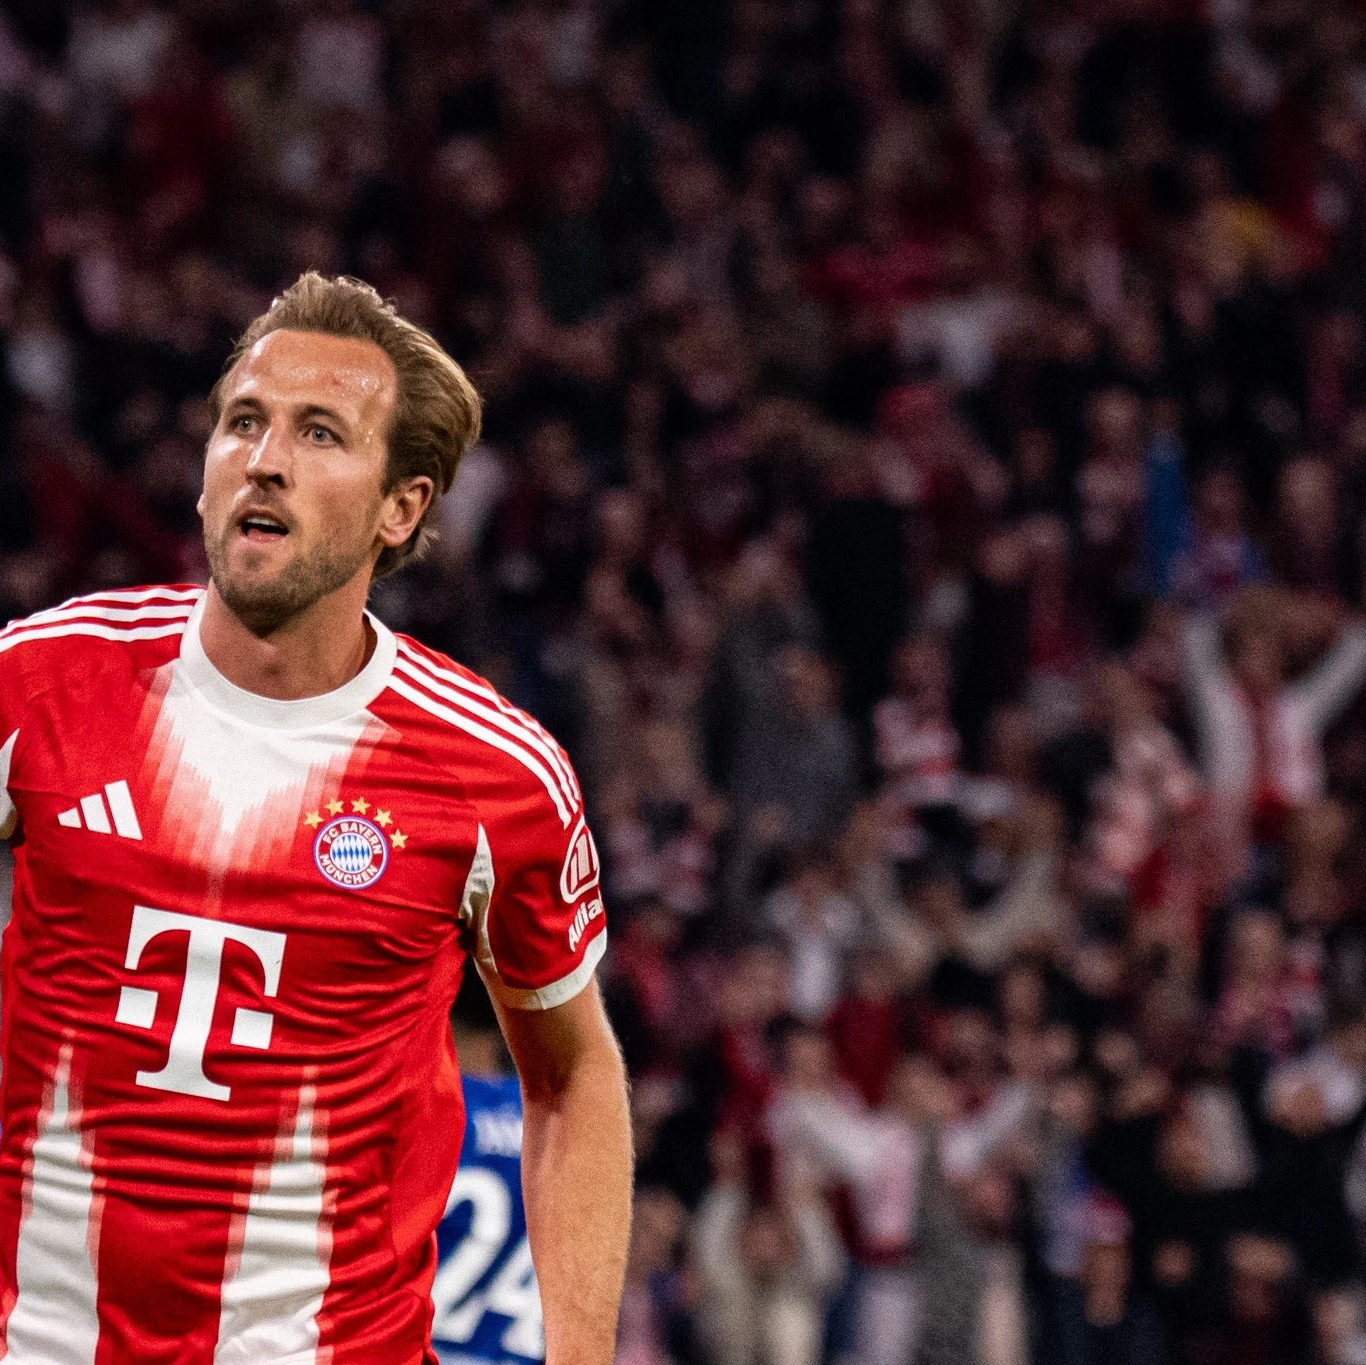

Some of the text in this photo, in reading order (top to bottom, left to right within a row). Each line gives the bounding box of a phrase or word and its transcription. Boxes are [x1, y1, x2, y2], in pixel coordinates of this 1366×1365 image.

[323, 822, 382, 855] FC BAYERN
[568, 898, 604, 953] Allia
[115, 905, 287, 1101] T
